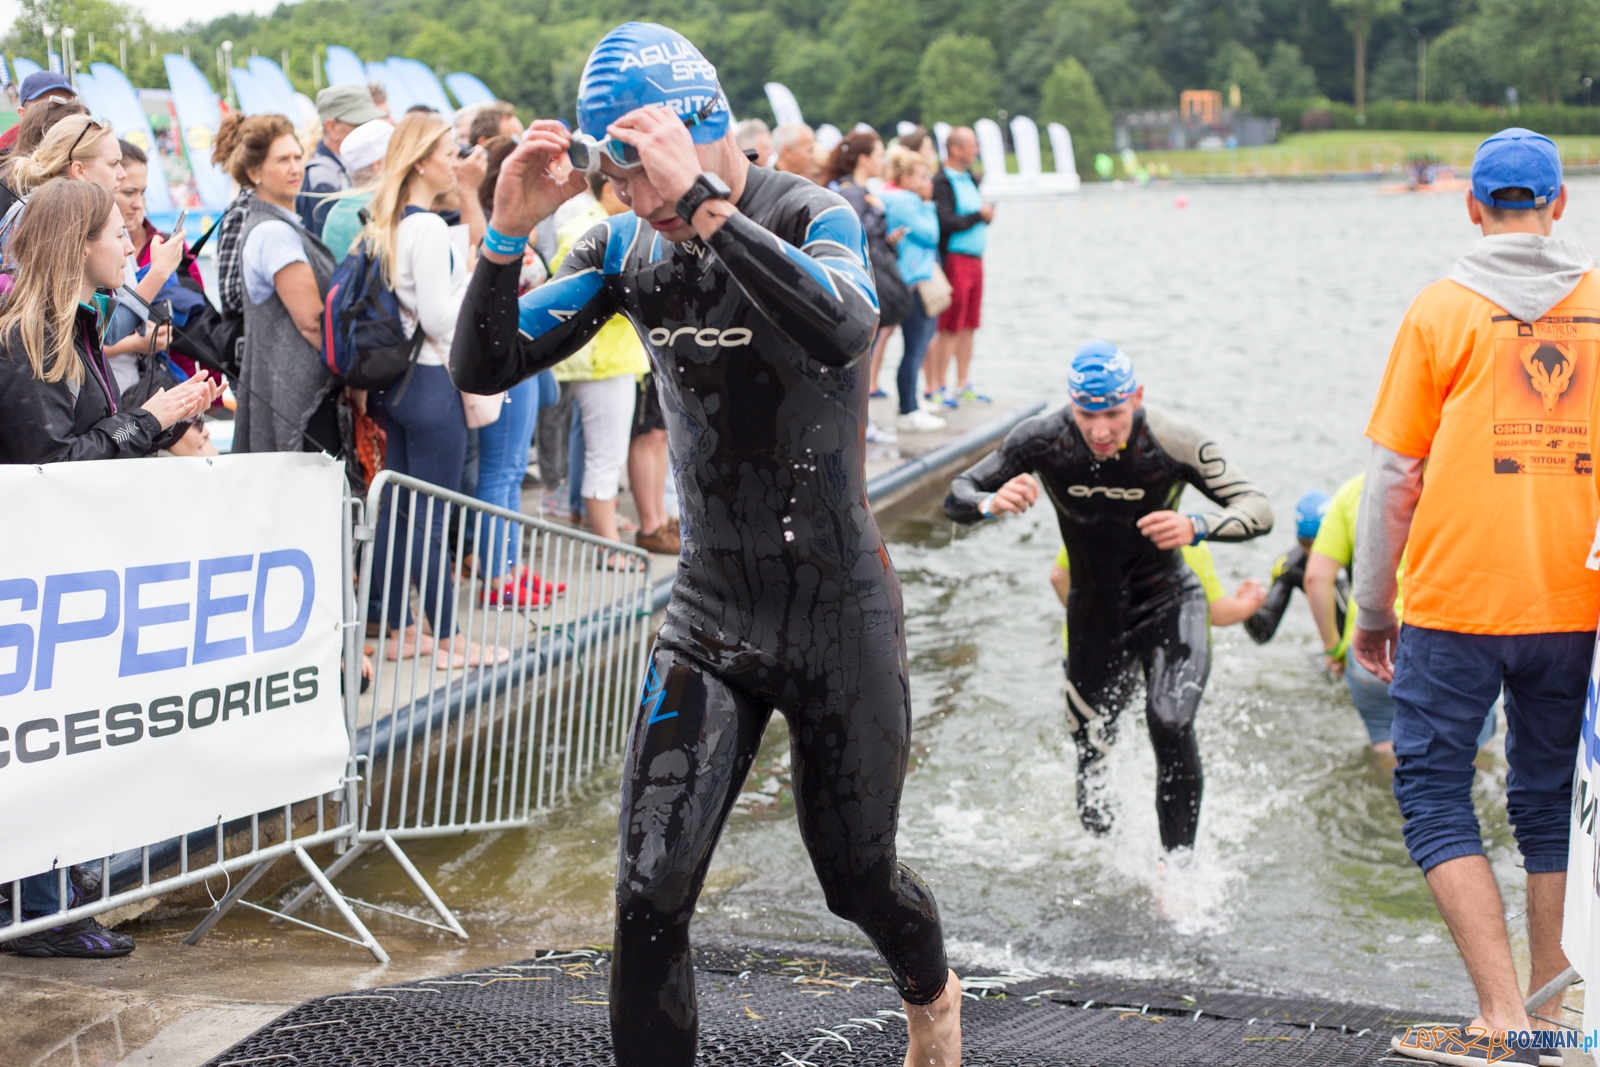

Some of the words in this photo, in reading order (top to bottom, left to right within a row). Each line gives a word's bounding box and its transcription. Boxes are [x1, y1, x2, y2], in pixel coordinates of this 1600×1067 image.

[620, 41, 696, 73] AQUA
[648, 326, 752, 348] orca
[1530, 456, 1566, 465] TRITOUR
[1067, 485, 1145, 500] orca
[0, 665, 319, 769] CESSORIES
